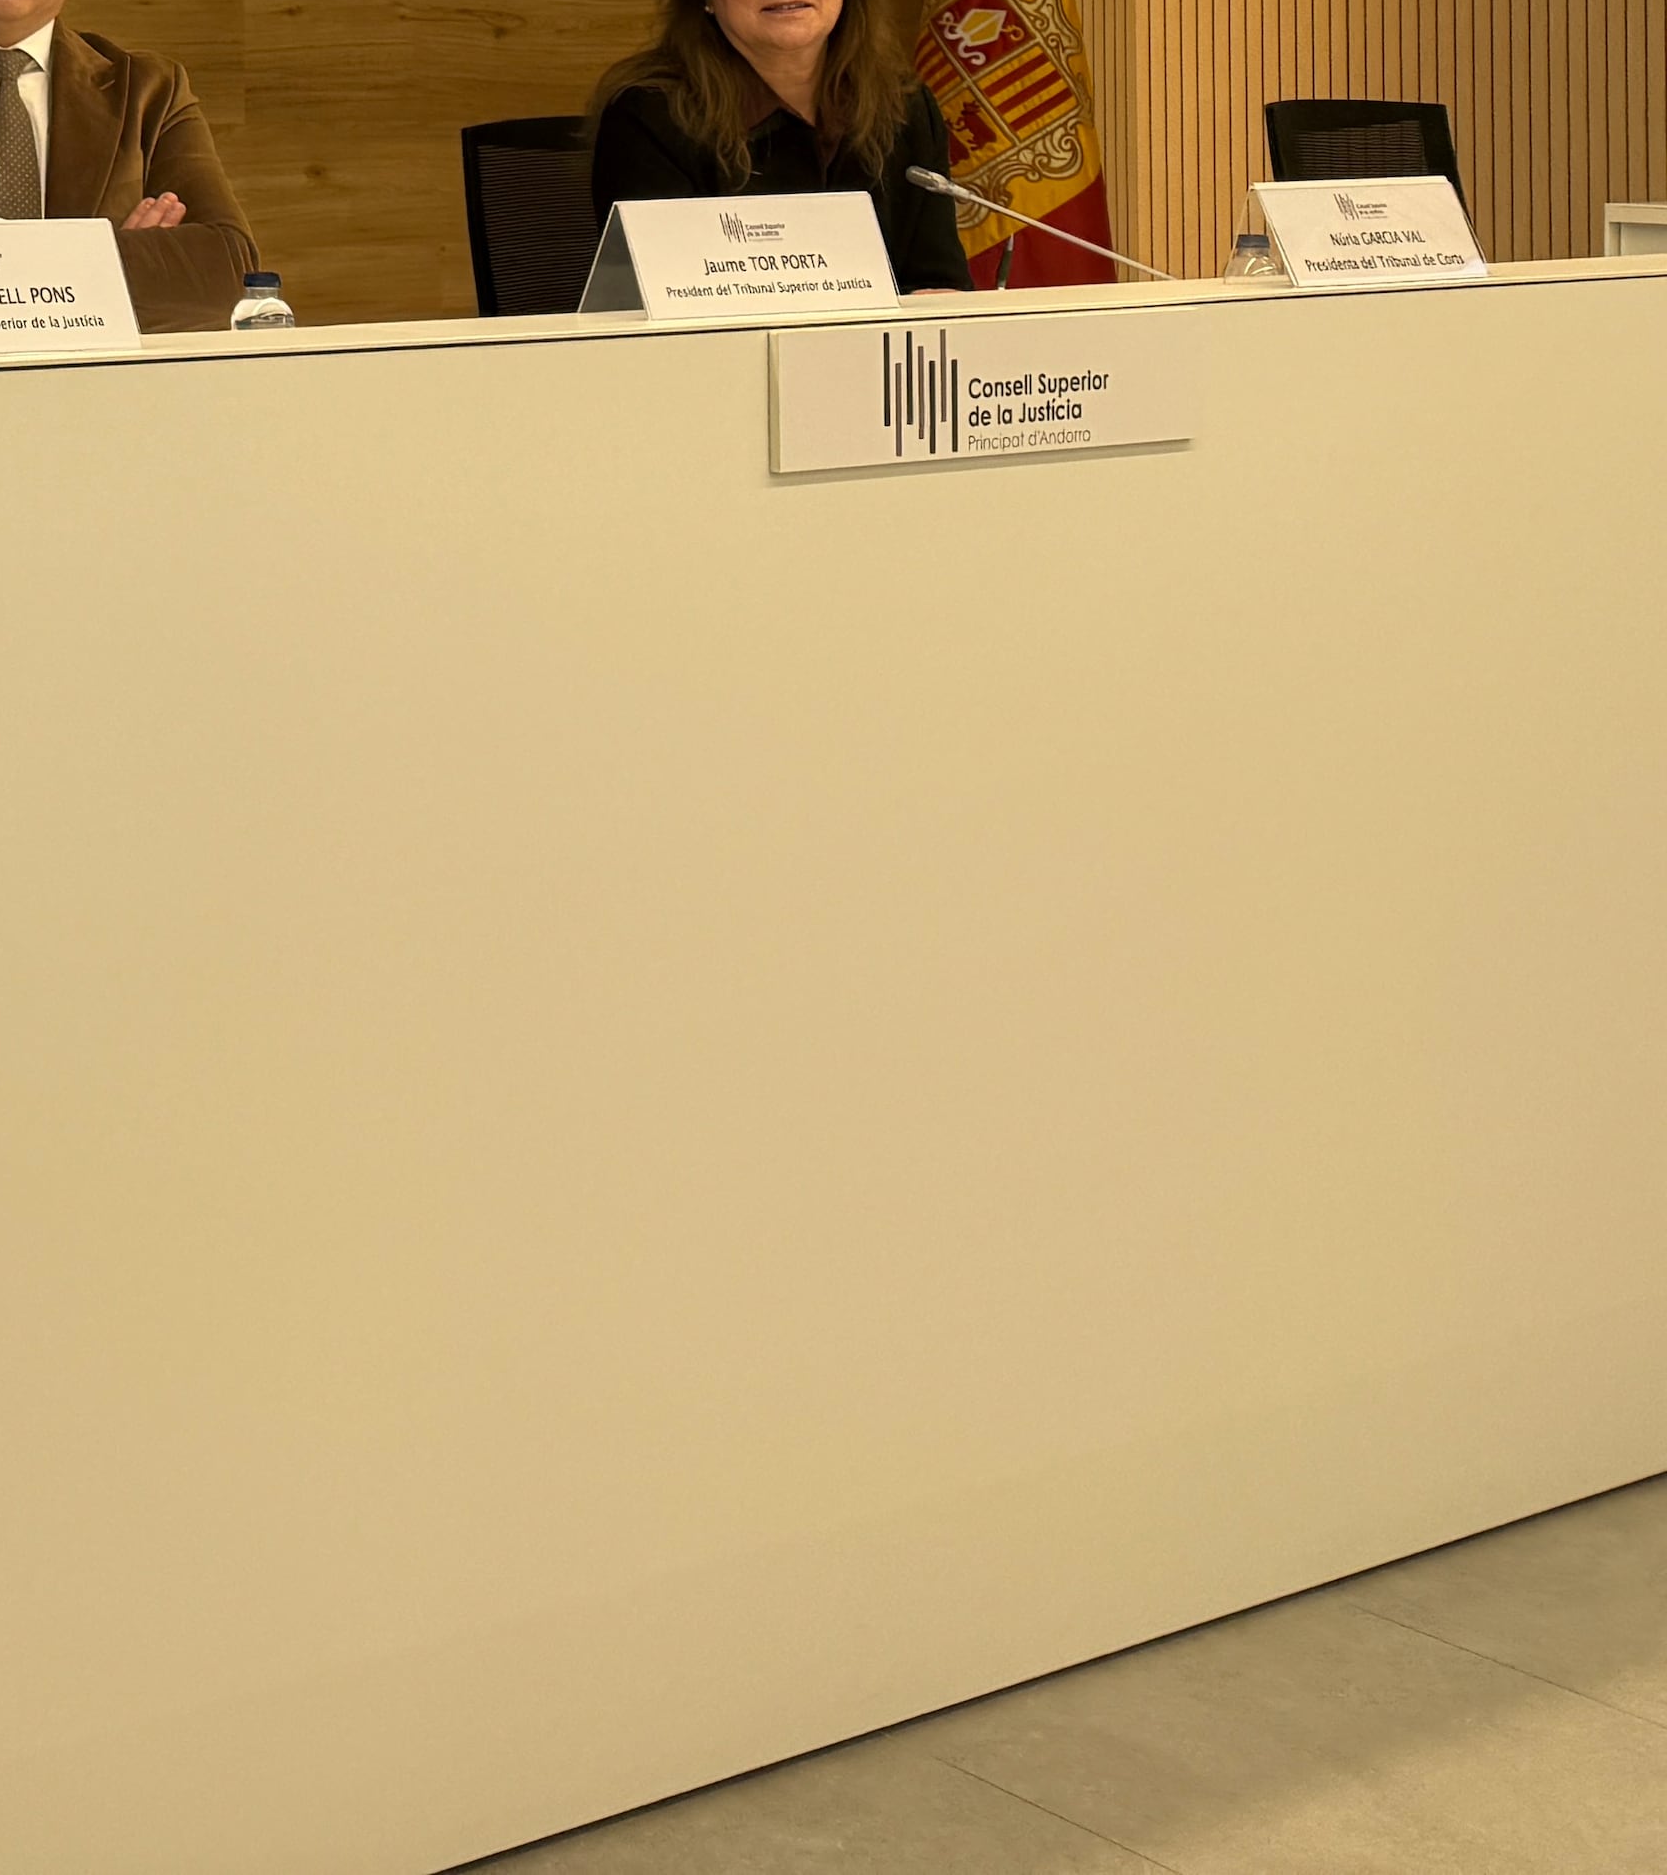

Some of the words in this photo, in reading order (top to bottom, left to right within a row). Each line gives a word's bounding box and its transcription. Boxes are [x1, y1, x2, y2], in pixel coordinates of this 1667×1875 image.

[1401, 230, 1426, 243] VAL
[704, 258, 747, 275] Jaume
[748, 255, 779, 271] TOR
[782, 253, 827, 270] PORTA
[1360, 256, 1378, 269] del
[1377, 254, 1421, 268] Tribunal
[1422, 253, 1436, 266] de
[30, 286, 75, 304] PONS
[666, 285, 714, 298] President
[716, 284, 732, 295] del
[733, 281, 775, 295] Tribunal
[777, 279, 819, 294] Superior
[822, 280, 835, 291] de
[836, 277, 872, 291] Justícia
[31, 316, 46, 329] de
[49, 315, 61, 328] la
[63, 314, 105, 329] Justícia
[968, 374, 1032, 399] Consell
[1038, 370, 1109, 398] Superior
[968, 405, 991, 427] de
[997, 403, 1013, 425] la
[1019, 398, 1082, 423] Justícia
[968, 431, 1024, 452] Principat
[1028, 428, 1091, 446] d'Andorra
